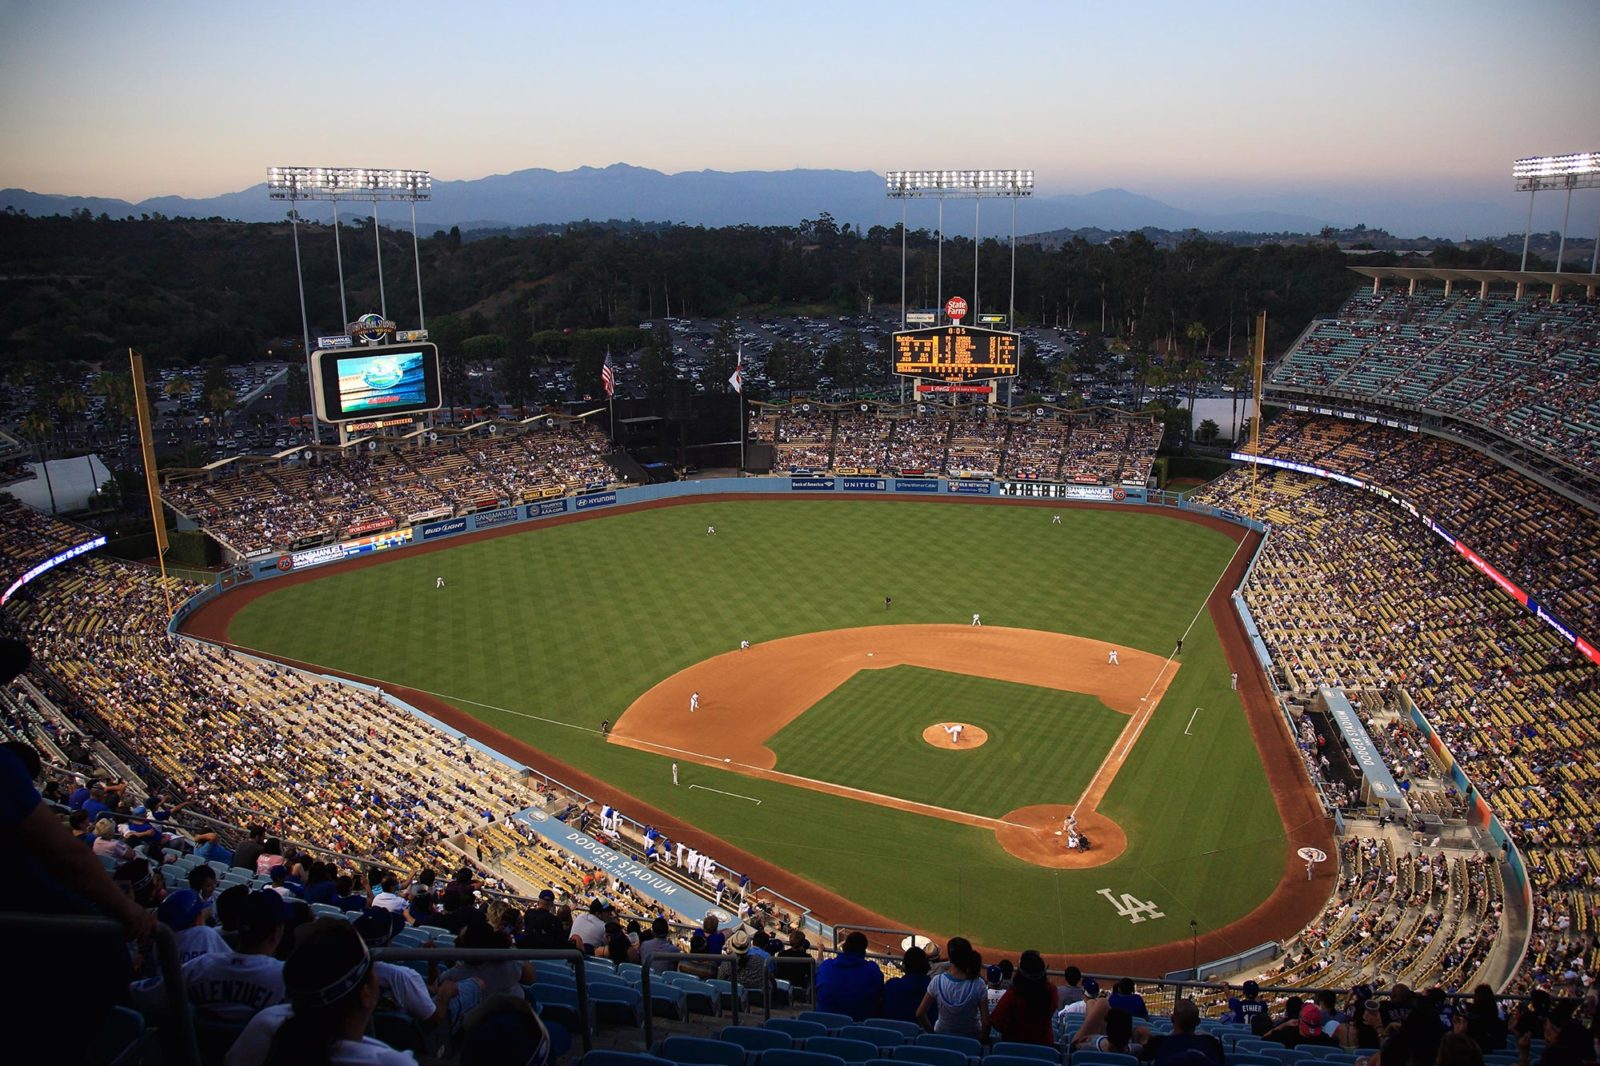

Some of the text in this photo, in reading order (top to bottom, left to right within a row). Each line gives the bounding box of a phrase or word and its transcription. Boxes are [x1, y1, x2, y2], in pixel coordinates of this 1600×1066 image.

[588, 495, 616, 504] HYUNDAI
[493, 509, 517, 519] MANUEL
[367, 519, 394, 530] AUTHORITY
[445, 523, 464, 531] LIGHT
[292, 553, 308, 562] SAN
[313, 545, 342, 558] MANUEL
[280, 559, 290, 568] 76
[1336, 710, 1375, 766] DODGER STADIUM
[566, 833, 677, 896] DODGER STADIUM
[592, 858, 612, 870] SINCE
[1096, 888, 1166, 924] LA
[1242, 1004, 1262, 1013] ETHIER
